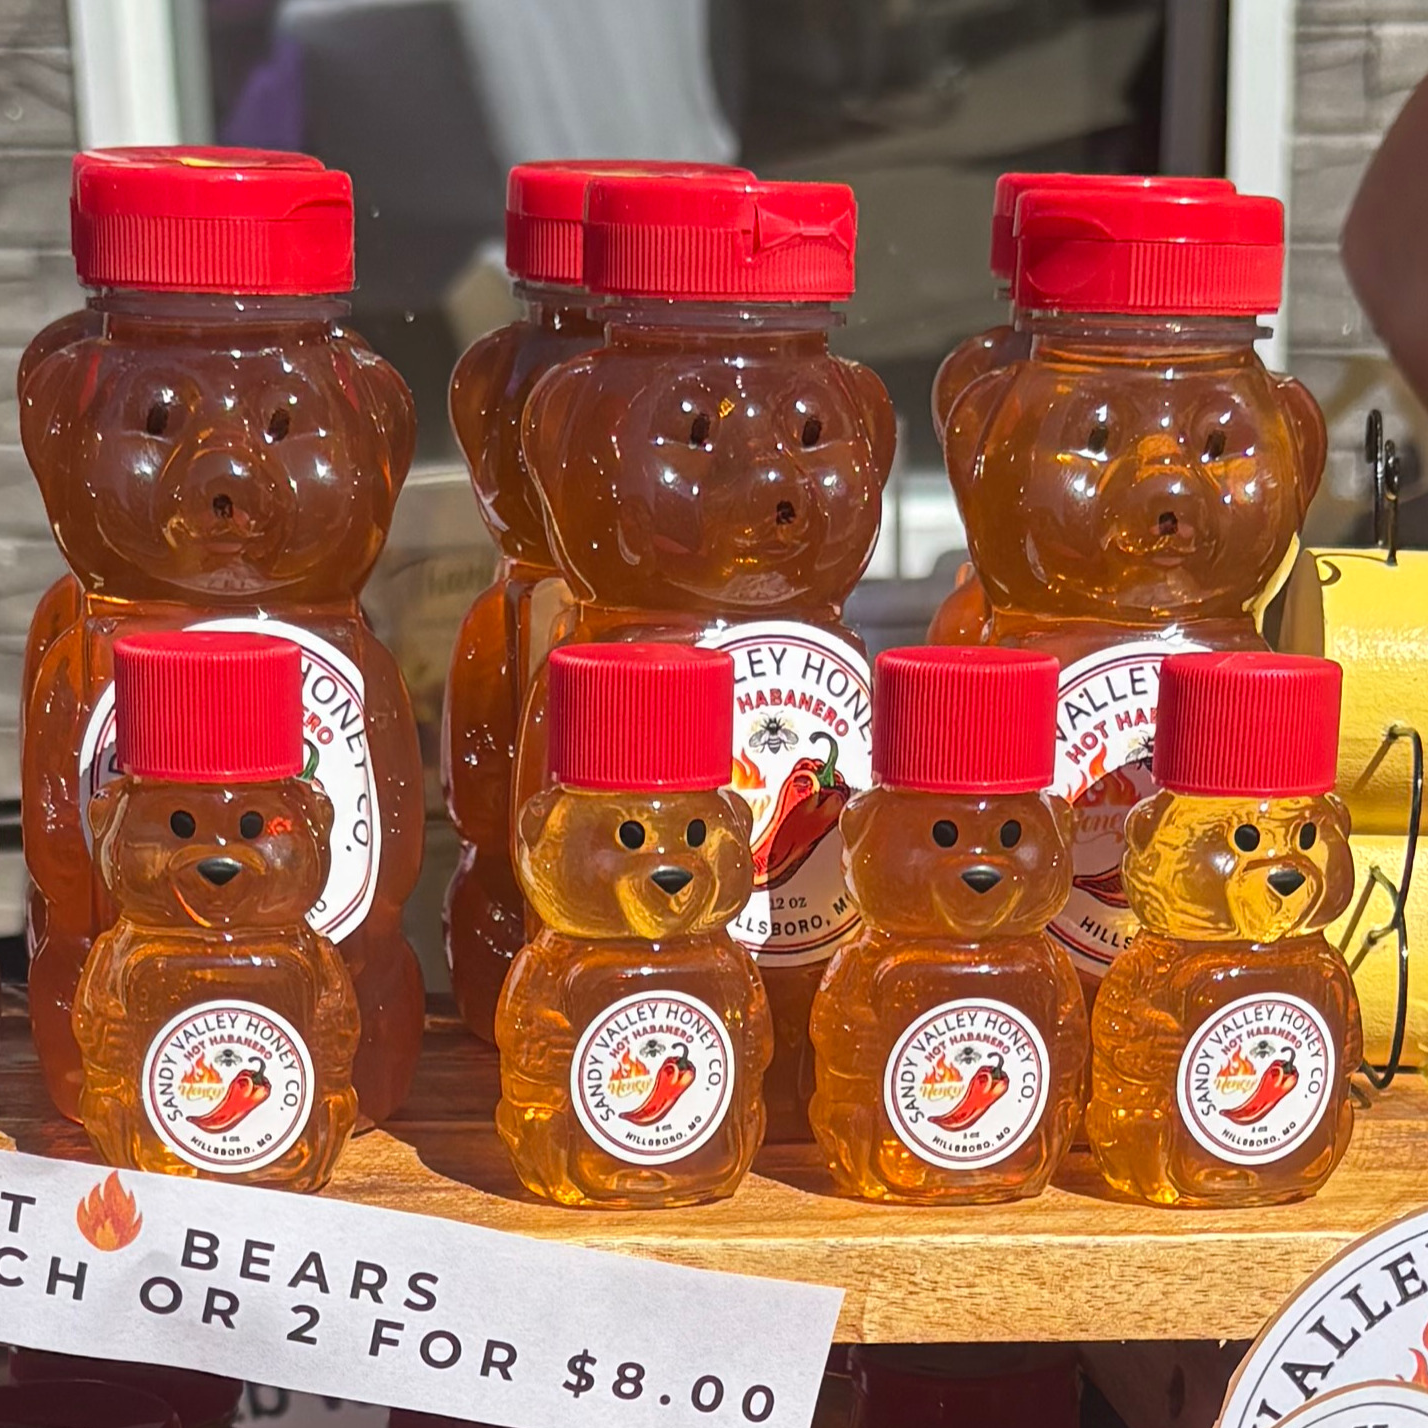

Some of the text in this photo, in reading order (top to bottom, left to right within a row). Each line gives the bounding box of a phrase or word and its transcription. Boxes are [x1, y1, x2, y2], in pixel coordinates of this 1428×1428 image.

[737, 688, 849, 737] HABANERO
[1064, 720, 1111, 765] HOT
[789, 897, 808, 909] OZ
[170, 1014, 239, 1052] VALLEY
[245, 1019, 299, 1071] HONEY
[595, 1003, 657, 1049] VALLEY
[666, 1004, 718, 1051] HONEY
[912, 1012, 978, 1052] VALLEY
[984, 1016, 1034, 1064] HONEY
[1194, 1049, 1217, 1117] SANDY
[1209, 1006, 1276, 1046] VALLEY
[1280, 1006, 1323, 1059] HONEY
[159, 1053, 183, 1122] SANDY
[587, 1055, 616, 1121] SANDY
[900, 1056, 925, 1124] SANDY
[180, 1227, 440, 1312] BEARS
[139, 1276, 240, 1331] OR
[286, 1303, 321, 1346] 2
[368, 1318, 520, 1383] FOR
[562, 1348, 777, 1424] $8.00
